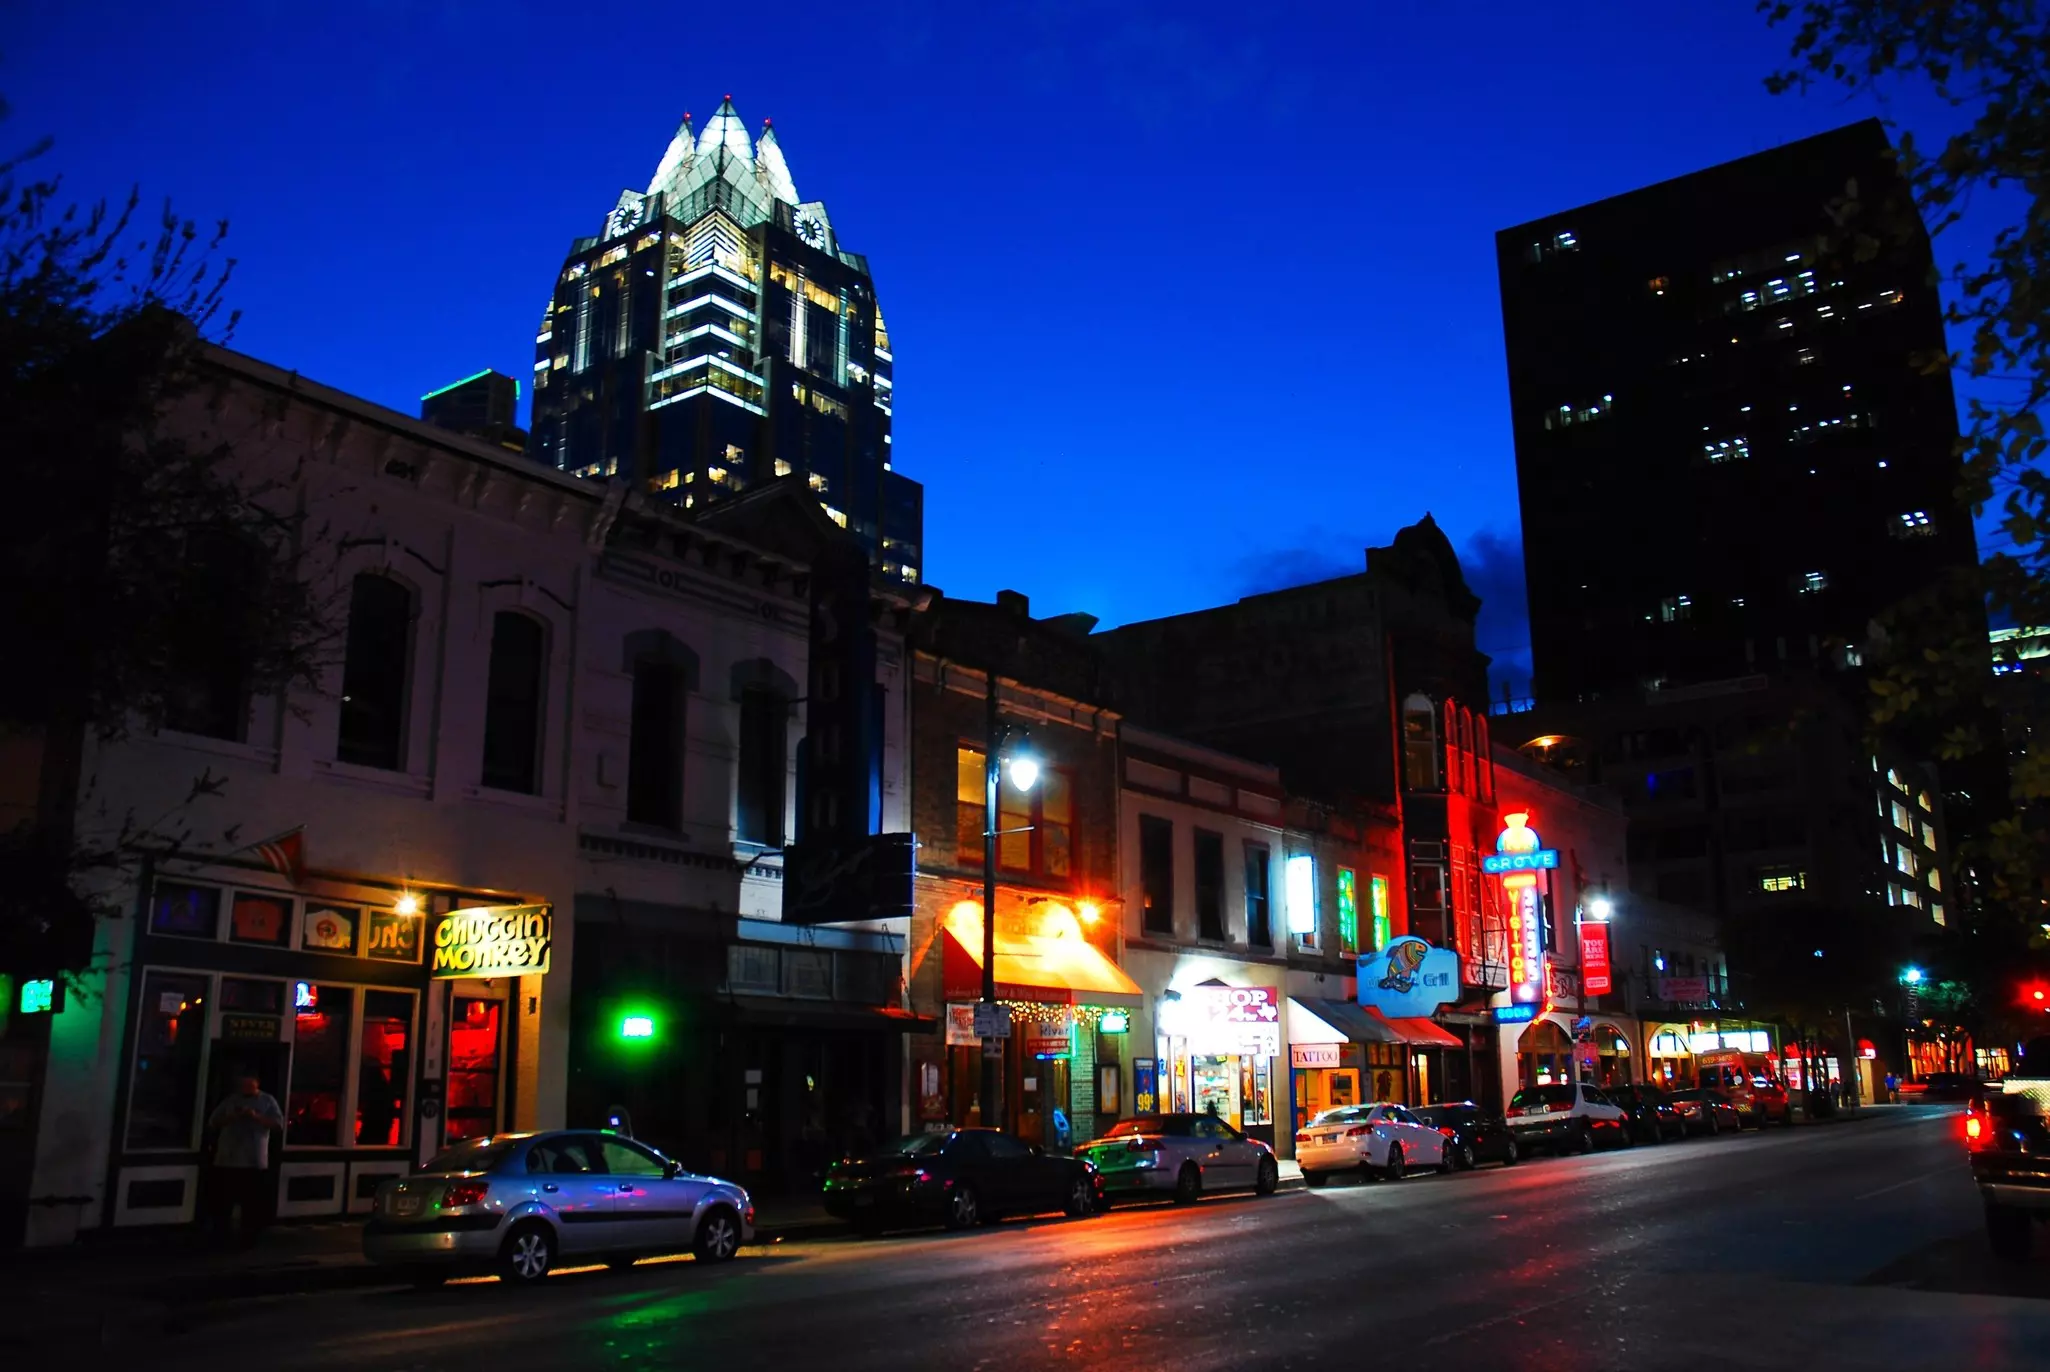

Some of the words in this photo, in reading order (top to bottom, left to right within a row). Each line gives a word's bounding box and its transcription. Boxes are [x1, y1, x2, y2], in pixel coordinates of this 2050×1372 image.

[1485, 853, 1554, 872] GROVE
[1508, 889, 1525, 984] VISITOR
[1496, 1007, 1532, 1020] SODA
[1293, 1051, 1338, 1062] TATTOO
